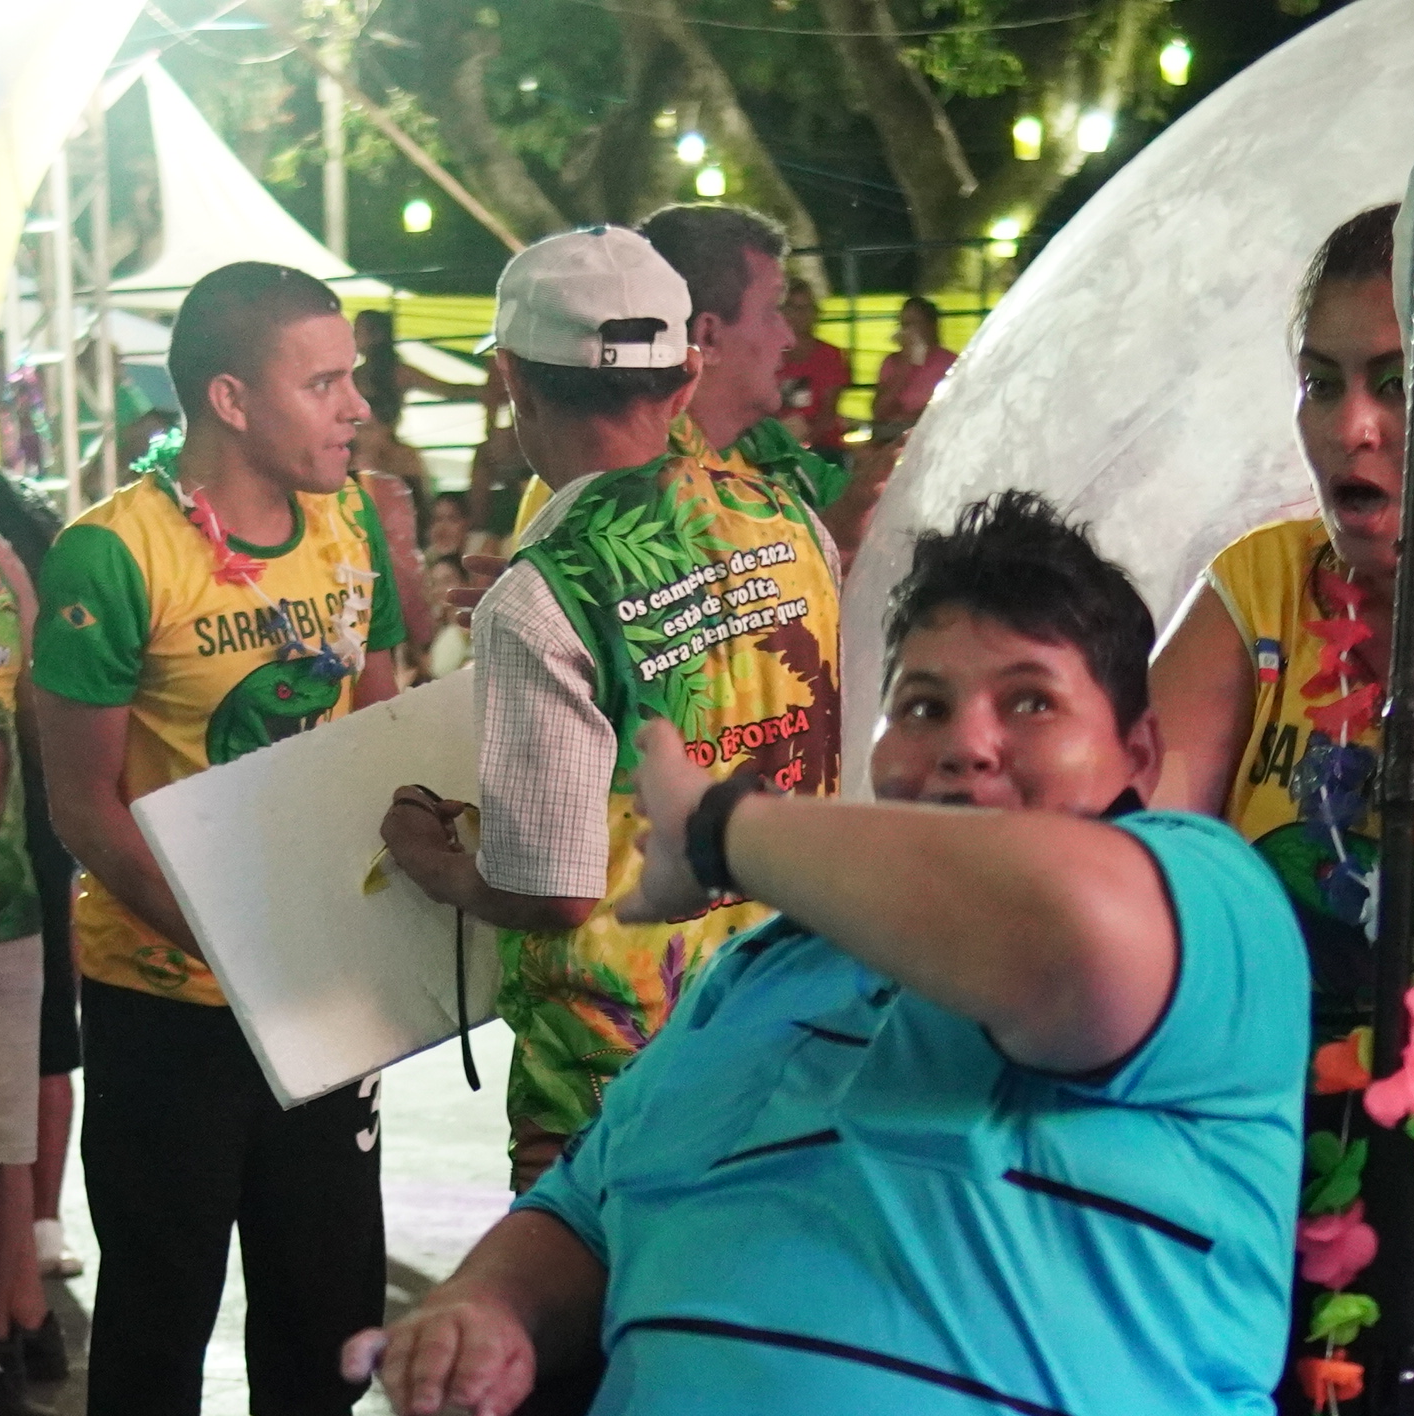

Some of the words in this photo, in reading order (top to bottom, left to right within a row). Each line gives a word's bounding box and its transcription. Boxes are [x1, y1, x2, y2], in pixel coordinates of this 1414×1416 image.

[618, 600, 647, 621] Os
[730, 551, 757, 573] de
[639, 644, 691, 682] para
